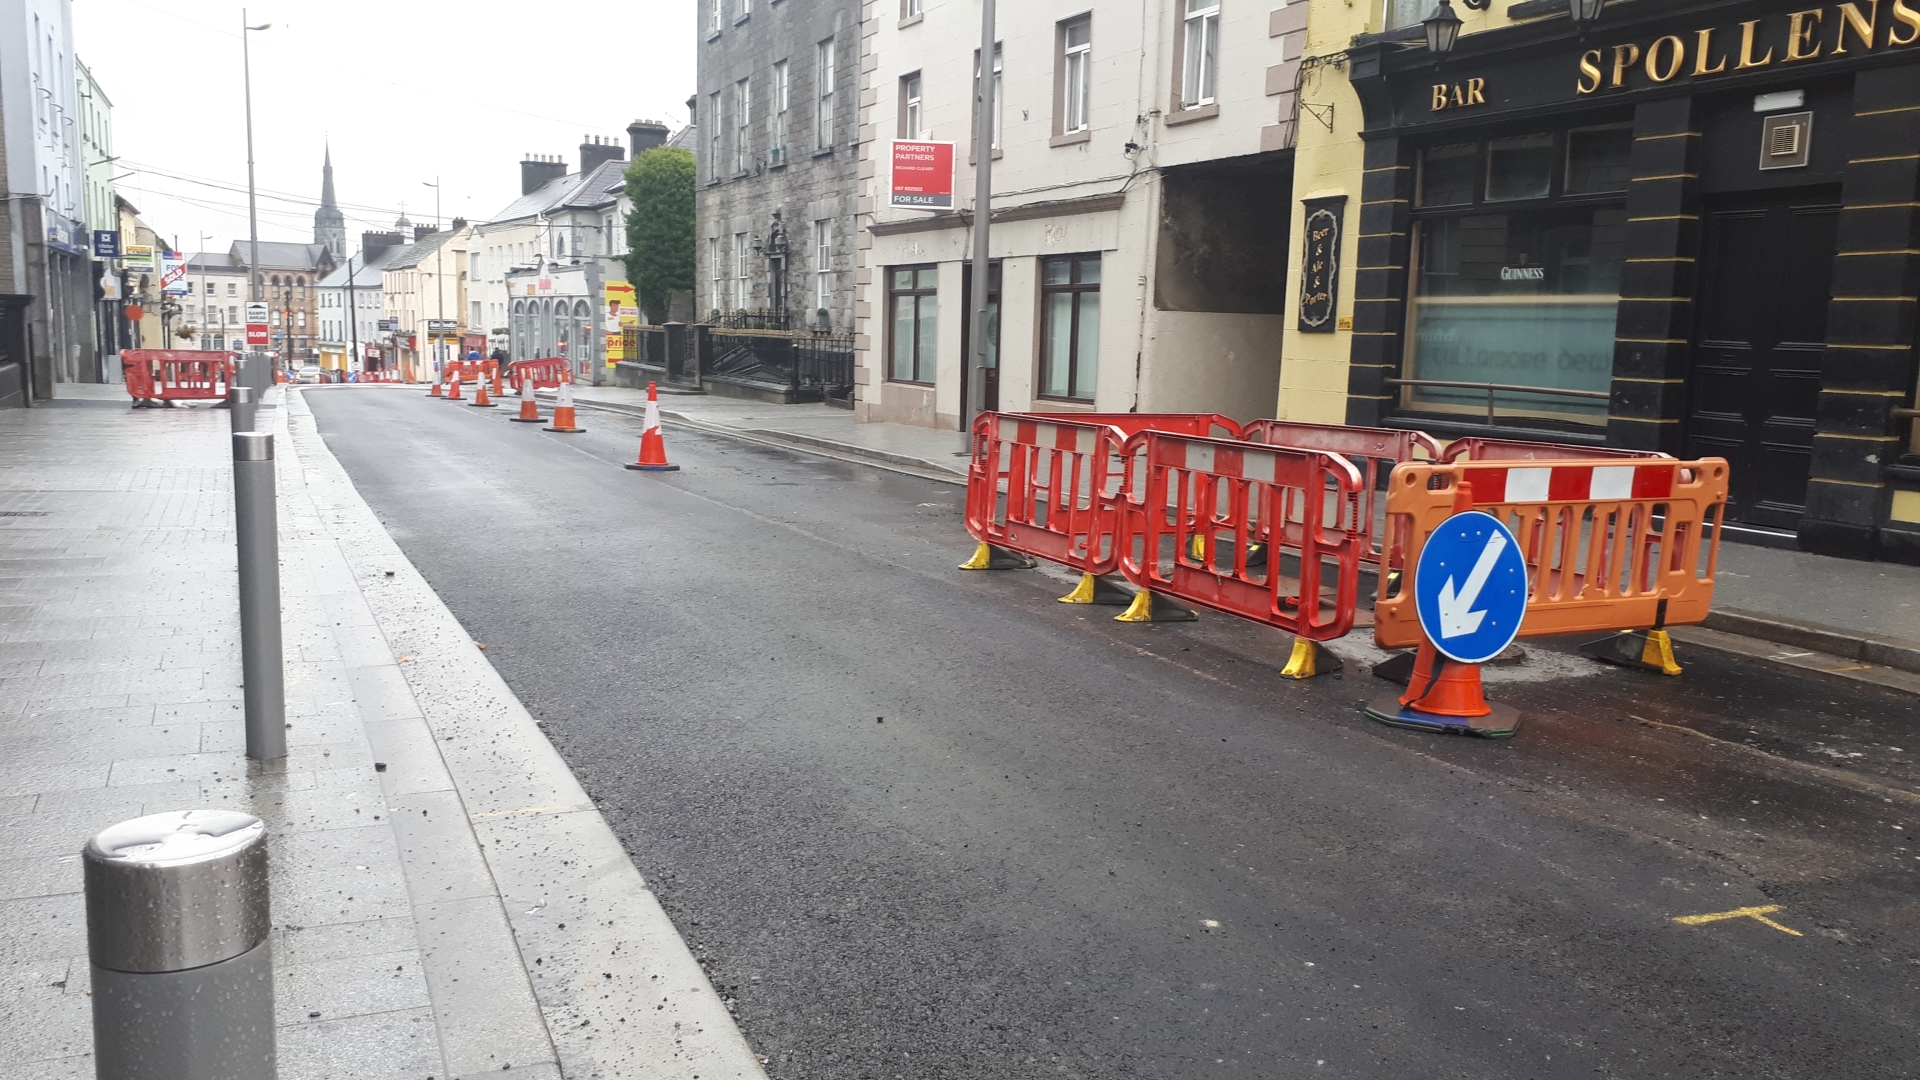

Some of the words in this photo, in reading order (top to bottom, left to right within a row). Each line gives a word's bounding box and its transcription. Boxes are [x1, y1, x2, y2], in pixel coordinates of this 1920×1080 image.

[1577, 0, 1920, 94] SPOLLENS
[1430, 78, 1485, 111] BAR
[895, 144, 935, 152] PROPERTY
[895, 153, 934, 161] PARTNERS
[894, 195, 911, 203] FOR
[912, 196, 934, 204] SALE
[1312, 227, 1330, 242] Beer
[1315, 243, 1324, 256] &
[1311, 260, 1324, 274] Ale
[1501, 266, 1544, 280] GUINNESS
[165, 268, 183, 284] SOLD
[1313, 275, 1321, 288] &
[1305, 292, 1327, 305] Porter
